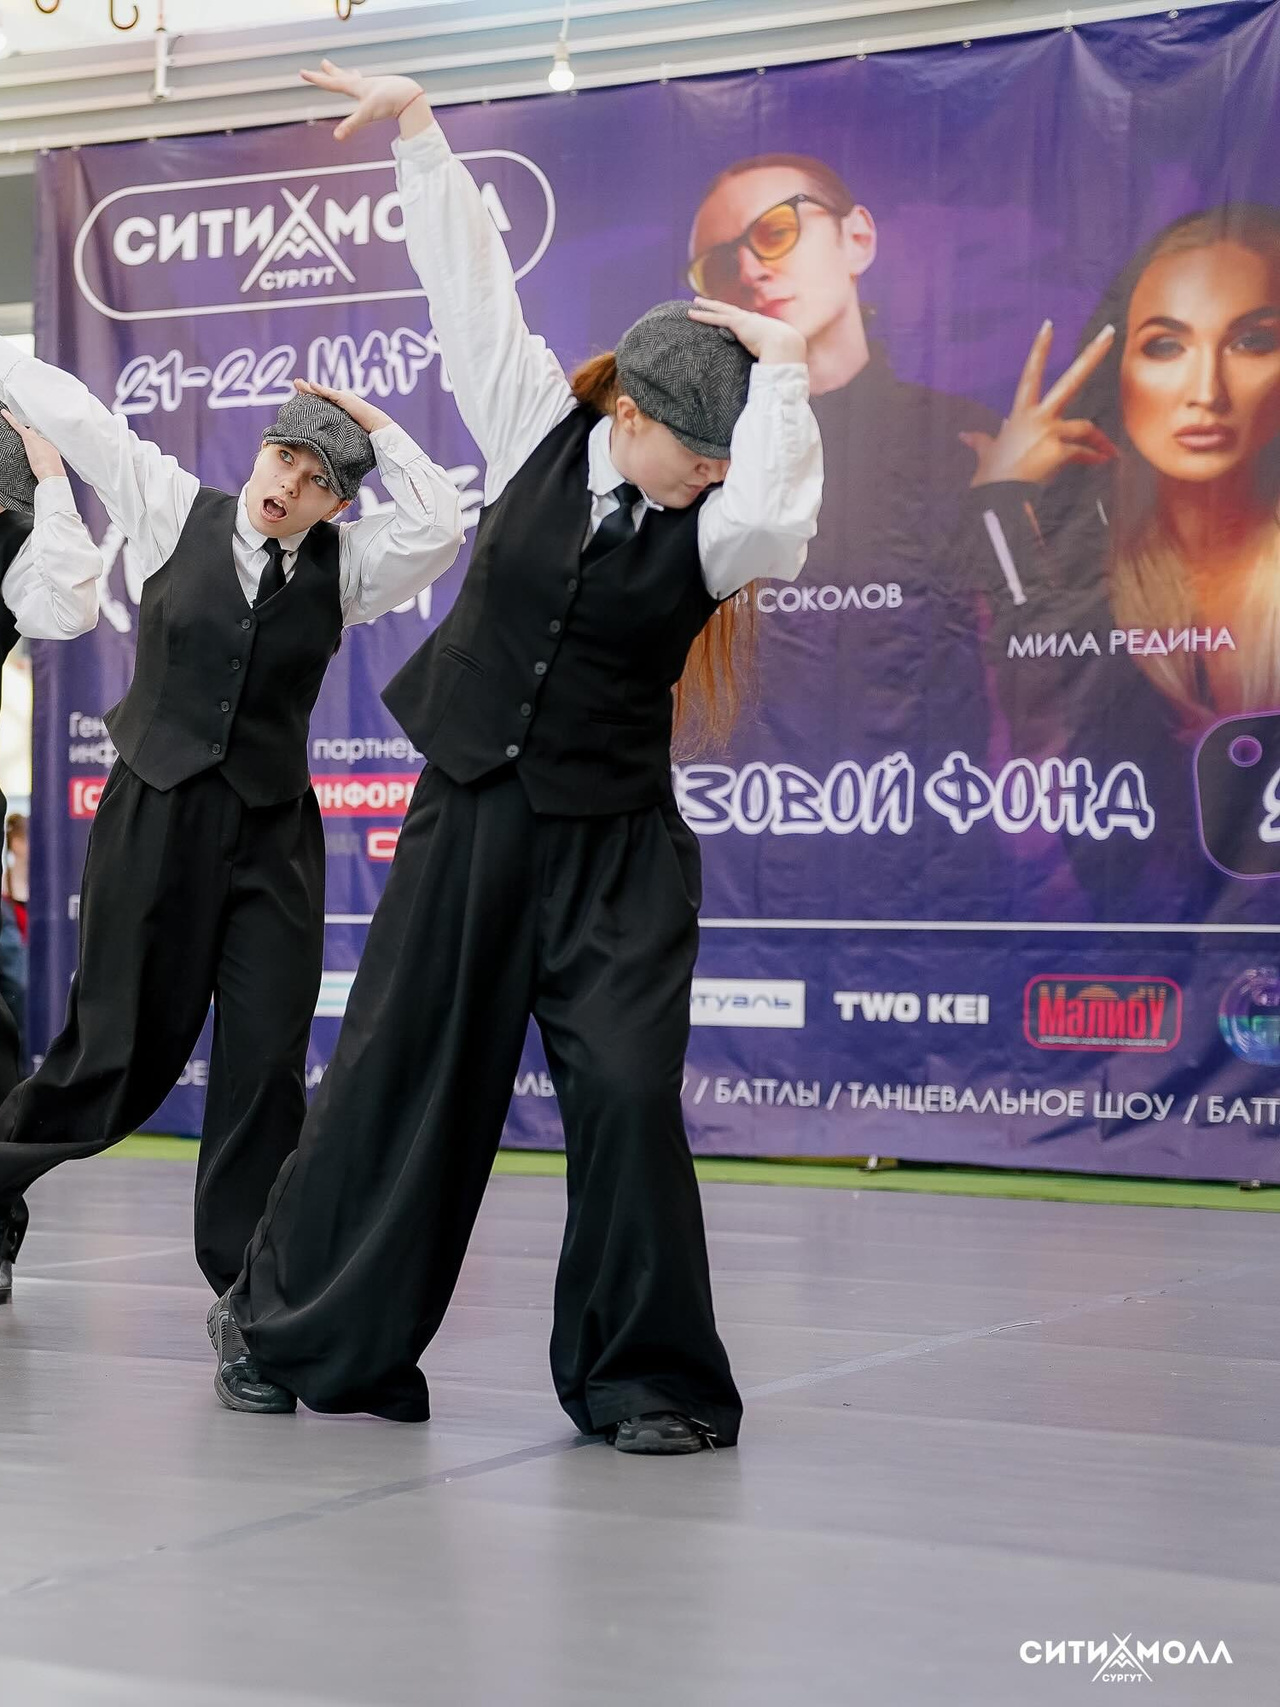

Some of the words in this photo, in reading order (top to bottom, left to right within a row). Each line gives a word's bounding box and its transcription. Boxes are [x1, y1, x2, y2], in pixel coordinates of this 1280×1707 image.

[113, 205, 275, 266] СИТИ
[325, 181, 512, 244] МОЛ
[259, 264, 338, 290] СУРГУТ
[111, 344, 298, 415] 21-22
[307, 326, 454, 399] МАР
[756, 582, 904, 613] СОКОЛОВ
[1007, 631, 1101, 659] МИЛА
[1109, 627, 1236, 656] РЕДИНА
[671, 751, 915, 835] ЗОВОЙ
[923, 751, 1155, 841] ФОНД
[833, 991, 920, 1022] TWO
[927, 994, 989, 1024] KEI
[714, 1077, 820, 1107] БАТТЛЫ
[848, 1081, 1085, 1117] ТАНЦЕВАЛЬНОЕ
[1093, 1091, 1174, 1121] ШОУ
[1207, 1095, 1280, 1125] БАТТ
